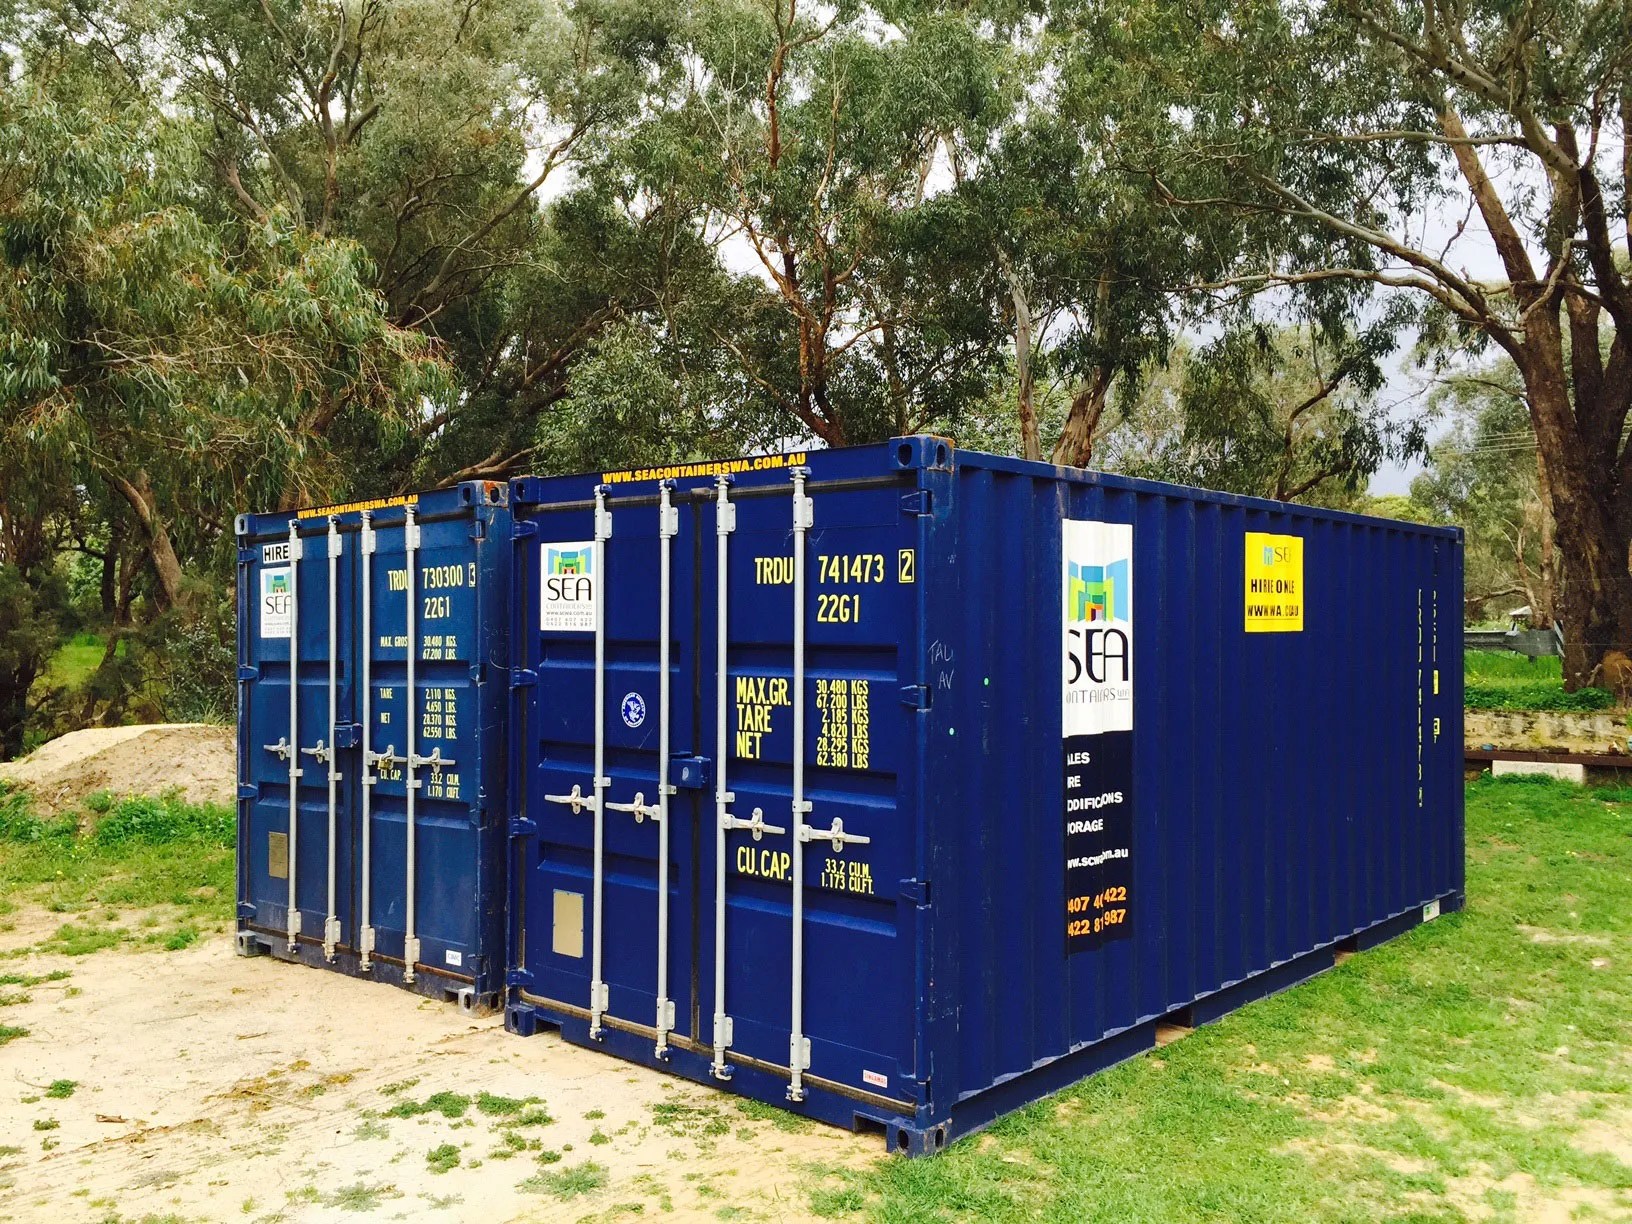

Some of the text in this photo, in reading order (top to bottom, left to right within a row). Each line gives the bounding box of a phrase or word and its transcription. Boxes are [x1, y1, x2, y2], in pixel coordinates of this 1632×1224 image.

[602, 453, 806, 484] WWW.SEACONTAINERSWA.COM.AU
[264, 545, 289, 561] HIRE
[754, 551, 913, 584] TRDU 741473 2
[422, 565, 463, 589] 730300
[546, 577, 592, 601] SEA
[424, 596, 450, 619] 22G1
[817, 594, 860, 623] 22G1
[380, 688, 393, 699] TARE
[851, 680, 869, 695] KGS
[851, 695, 868, 709] LBS
[381, 713, 390, 724] NET
[736, 704, 772, 732] TARE
[852, 709, 869, 724] KGS
[852, 724, 868, 739] LBS
[736, 731, 762, 759] NET
[852, 738, 869, 753] KGS
[852, 753, 868, 769] LBS
[1067, 752, 1090, 766] LES
[1067, 775, 1081, 788] RE
[1067, 819, 1104, 836] ORAGE
[825, 858, 846, 875] 33.2
[1067, 896, 1090, 913] 407
[1067, 919, 1090, 937] 422
